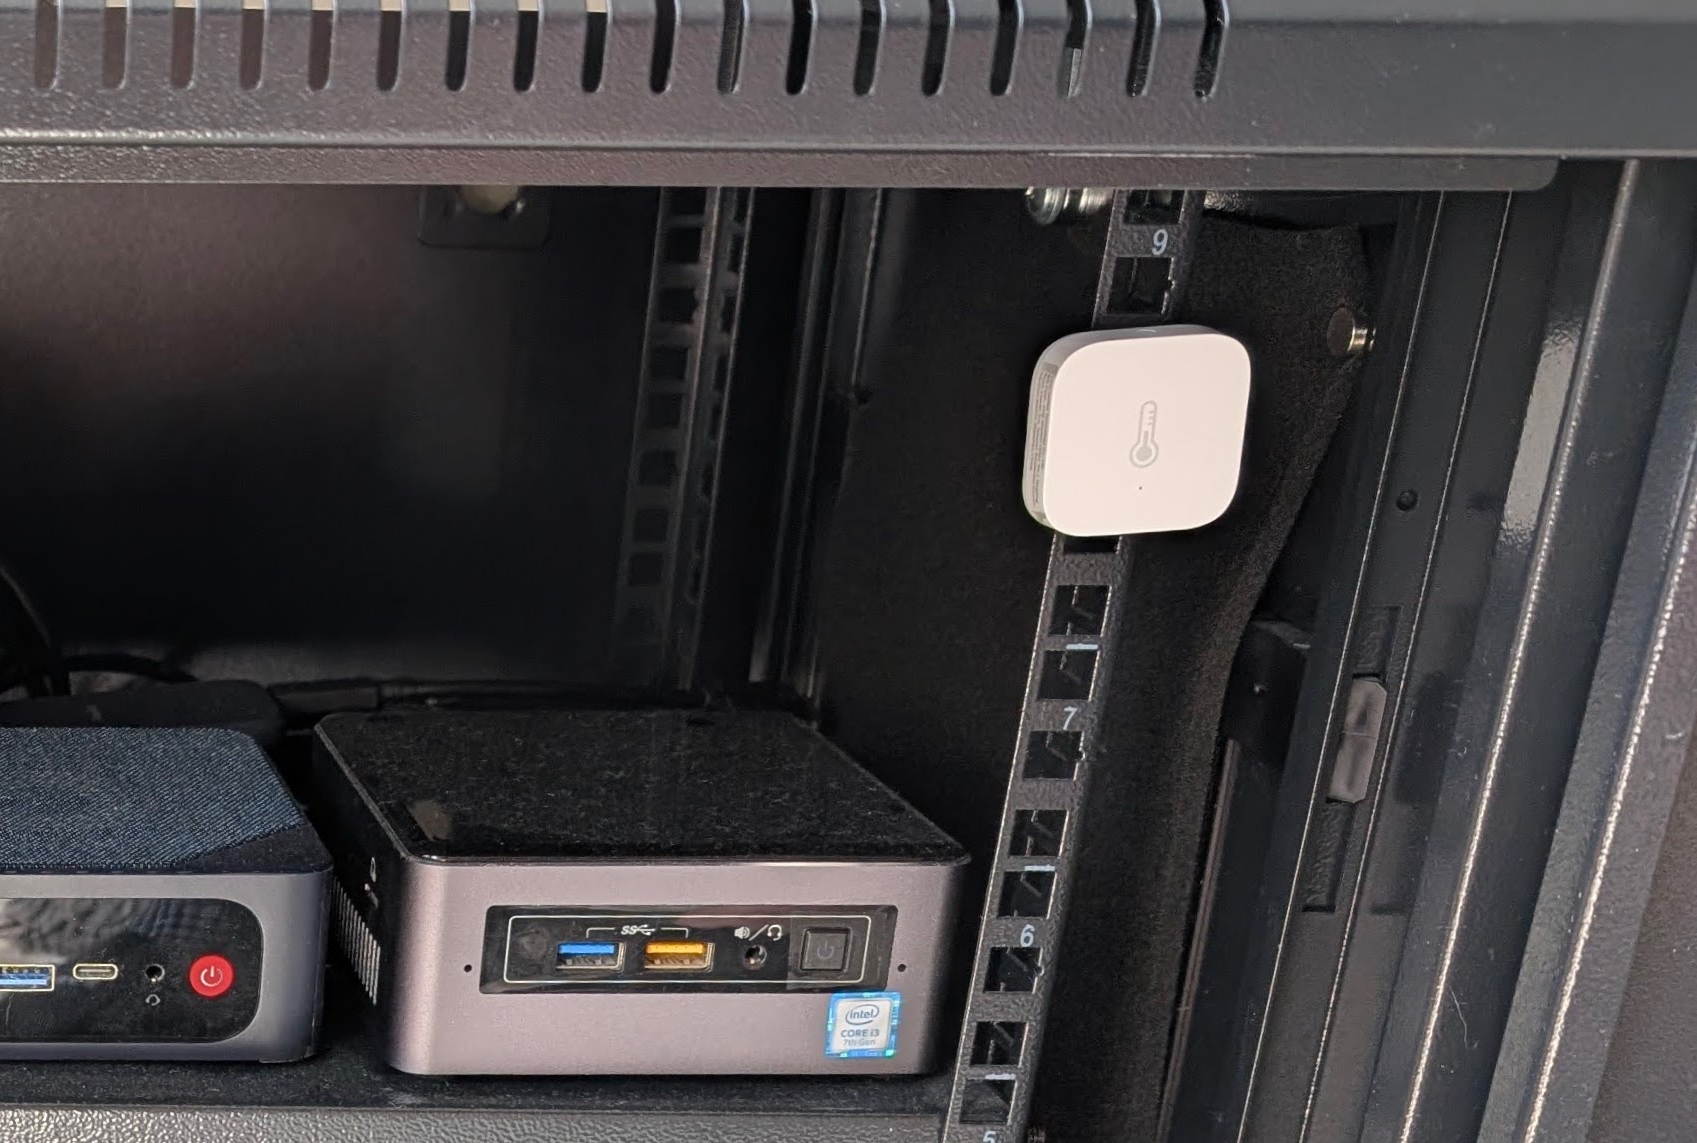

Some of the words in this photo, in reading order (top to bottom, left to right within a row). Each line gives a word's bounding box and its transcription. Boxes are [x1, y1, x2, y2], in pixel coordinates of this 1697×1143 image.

[1152, 229, 1168, 255] 9
[1063, 706, 1078, 730] 7
[1020, 924, 1034, 947] 6
[849, 1008, 874, 1019] intel
[841, 1029, 868, 1038] CORE
[870, 1029, 880, 1037] i3
[859, 1038, 876, 1047] Gen
